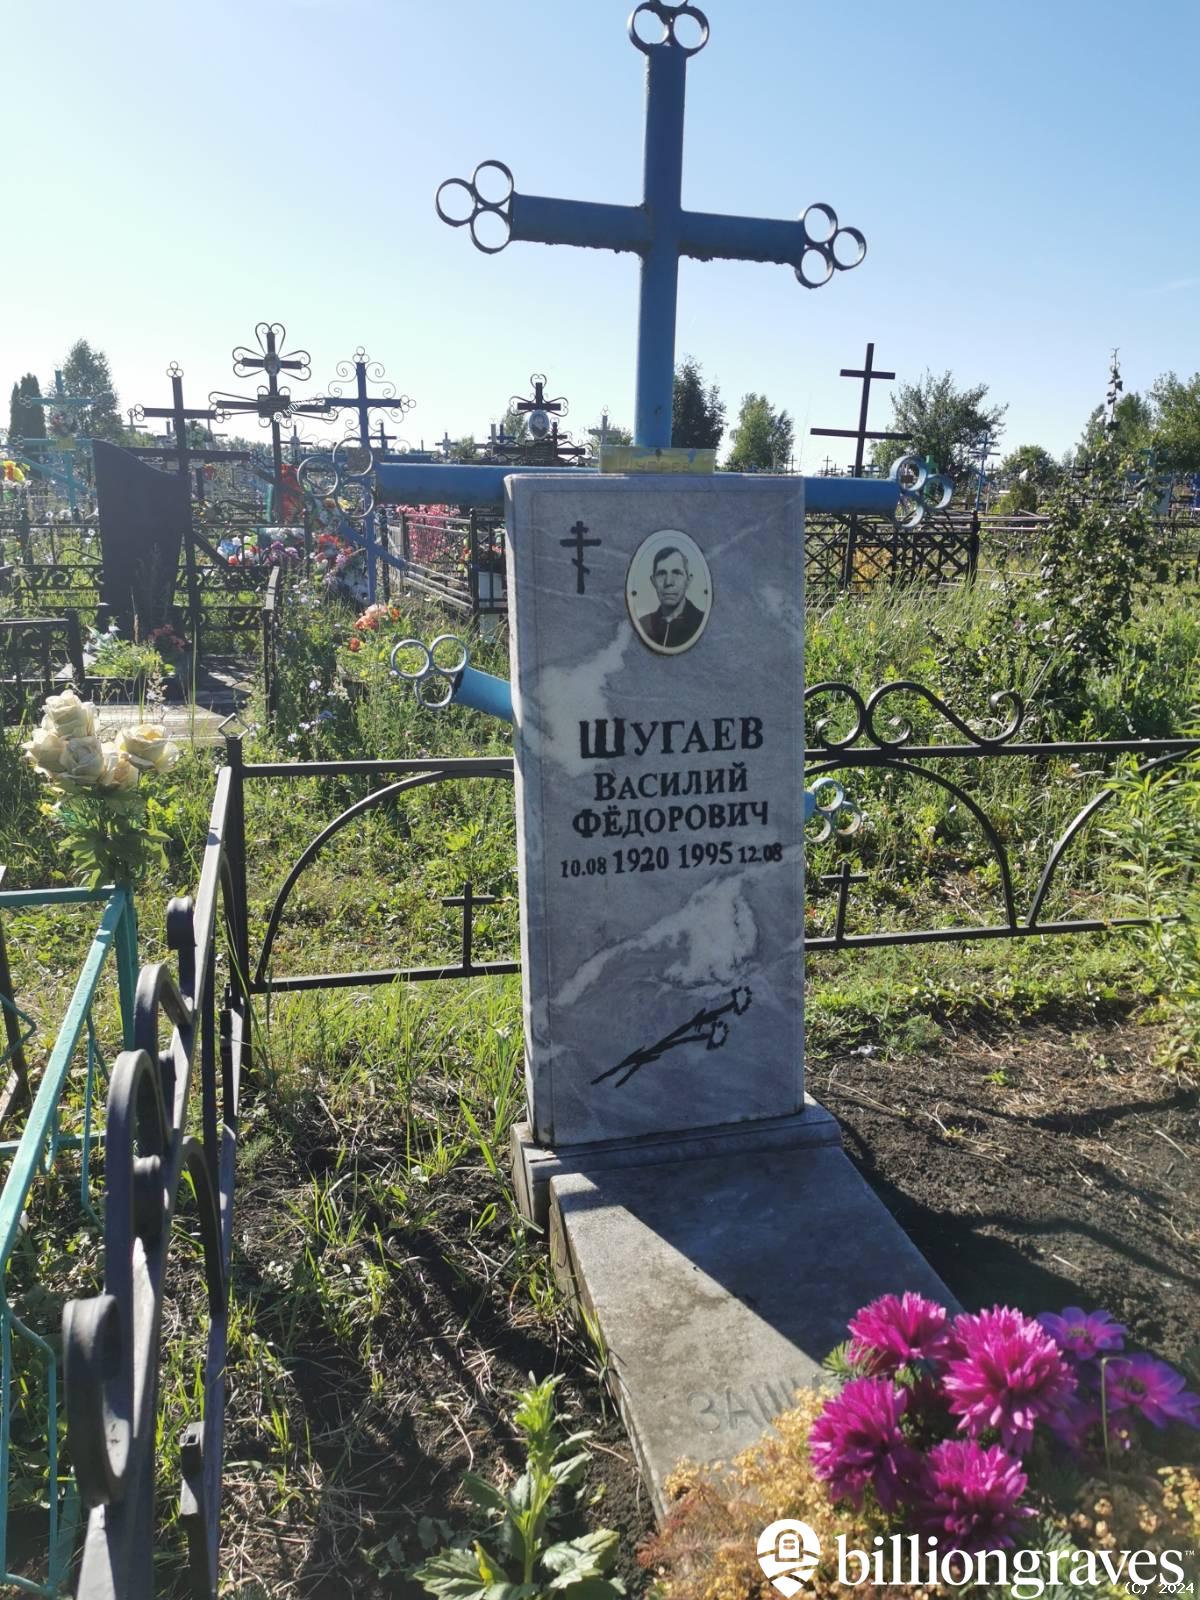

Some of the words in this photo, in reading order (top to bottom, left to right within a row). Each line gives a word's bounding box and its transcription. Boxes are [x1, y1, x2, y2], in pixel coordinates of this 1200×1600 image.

[579, 716, 764, 759] ШУГАЕВ
[593, 761, 748, 801] ВАСИЛИЙ
[572, 801, 769, 838] ФЁДОРОВИЧ
[560, 857, 607, 878] 10.08
[613, 846, 669, 873] 1920
[678, 841, 733, 869] 1995
[739, 842, 783, 864] 12.08
